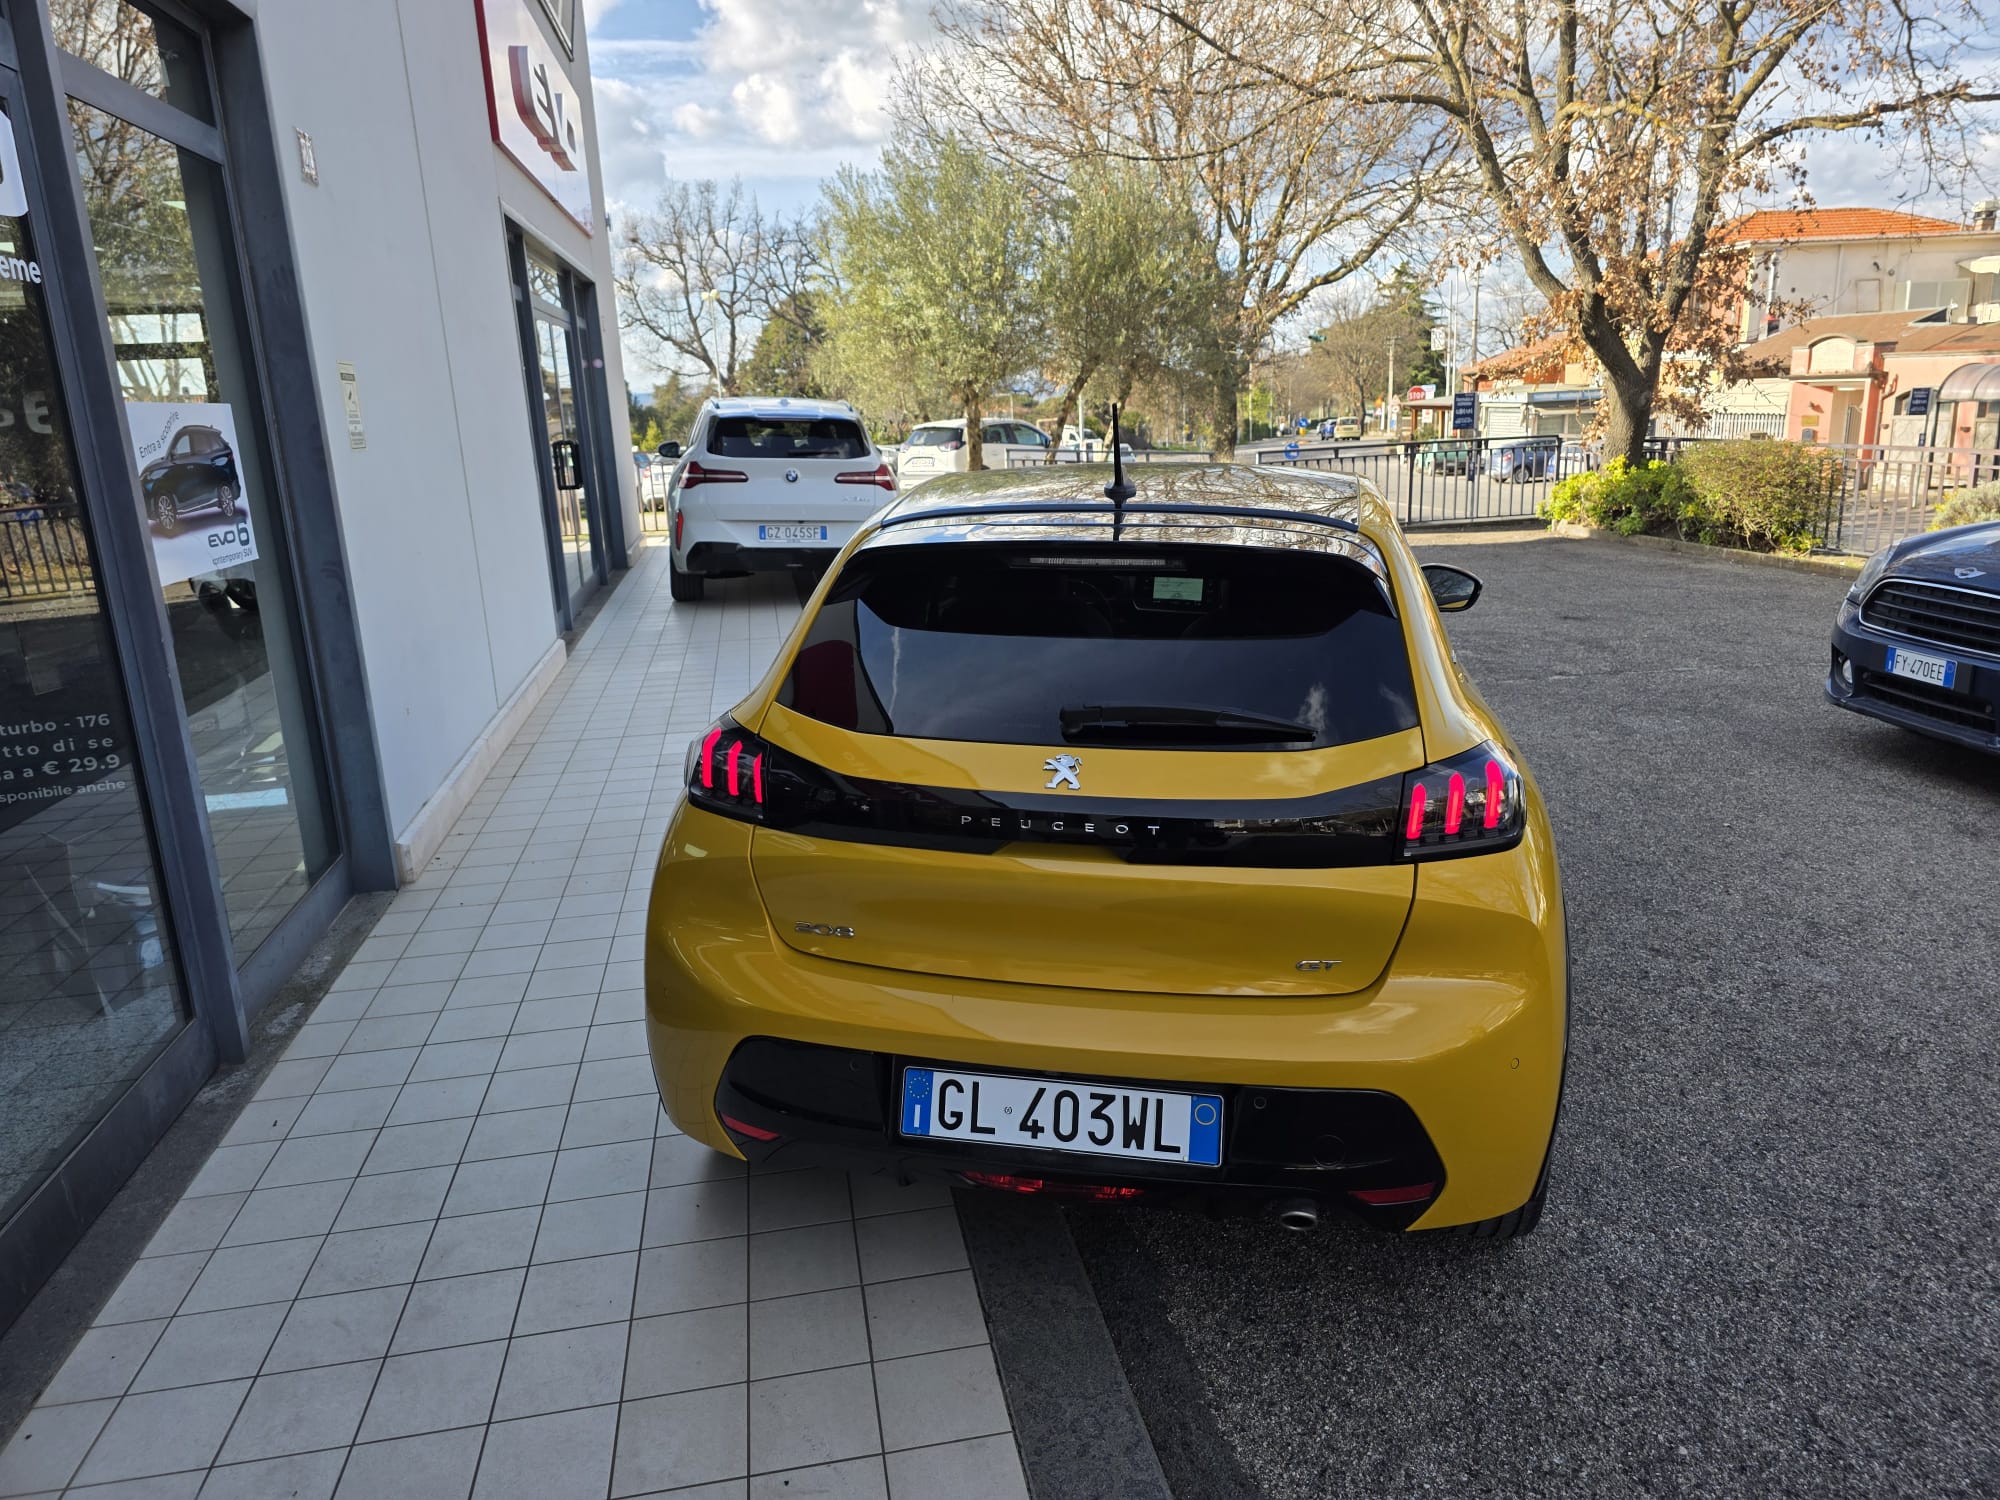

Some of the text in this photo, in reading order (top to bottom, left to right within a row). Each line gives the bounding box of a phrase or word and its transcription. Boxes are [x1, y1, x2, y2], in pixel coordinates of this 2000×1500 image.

[1408, 391, 1426, 401] STOP
[139, 442, 157, 459] Entra
[235, 519, 250, 547] 6
[1894, 653, 1908, 672] FY
[1910, 659, 1945, 681] 470EE
[0, 720, 57, 736] turbo
[76, 713, 111, 729] 176
[52, 738, 76, 753] di
[87, 737, 114, 749] se
[23, 767, 34, 778] a
[68, 754, 121, 773] 29.9
[77, 779, 127, 795] anche
[961, 815, 1160, 836] PEUGEOT
[794, 920, 855, 938] 208
[1295, 959, 1344, 972] GT
[937, 1078, 996, 1135] GL
[1018, 1086, 1182, 1154] 403WL
